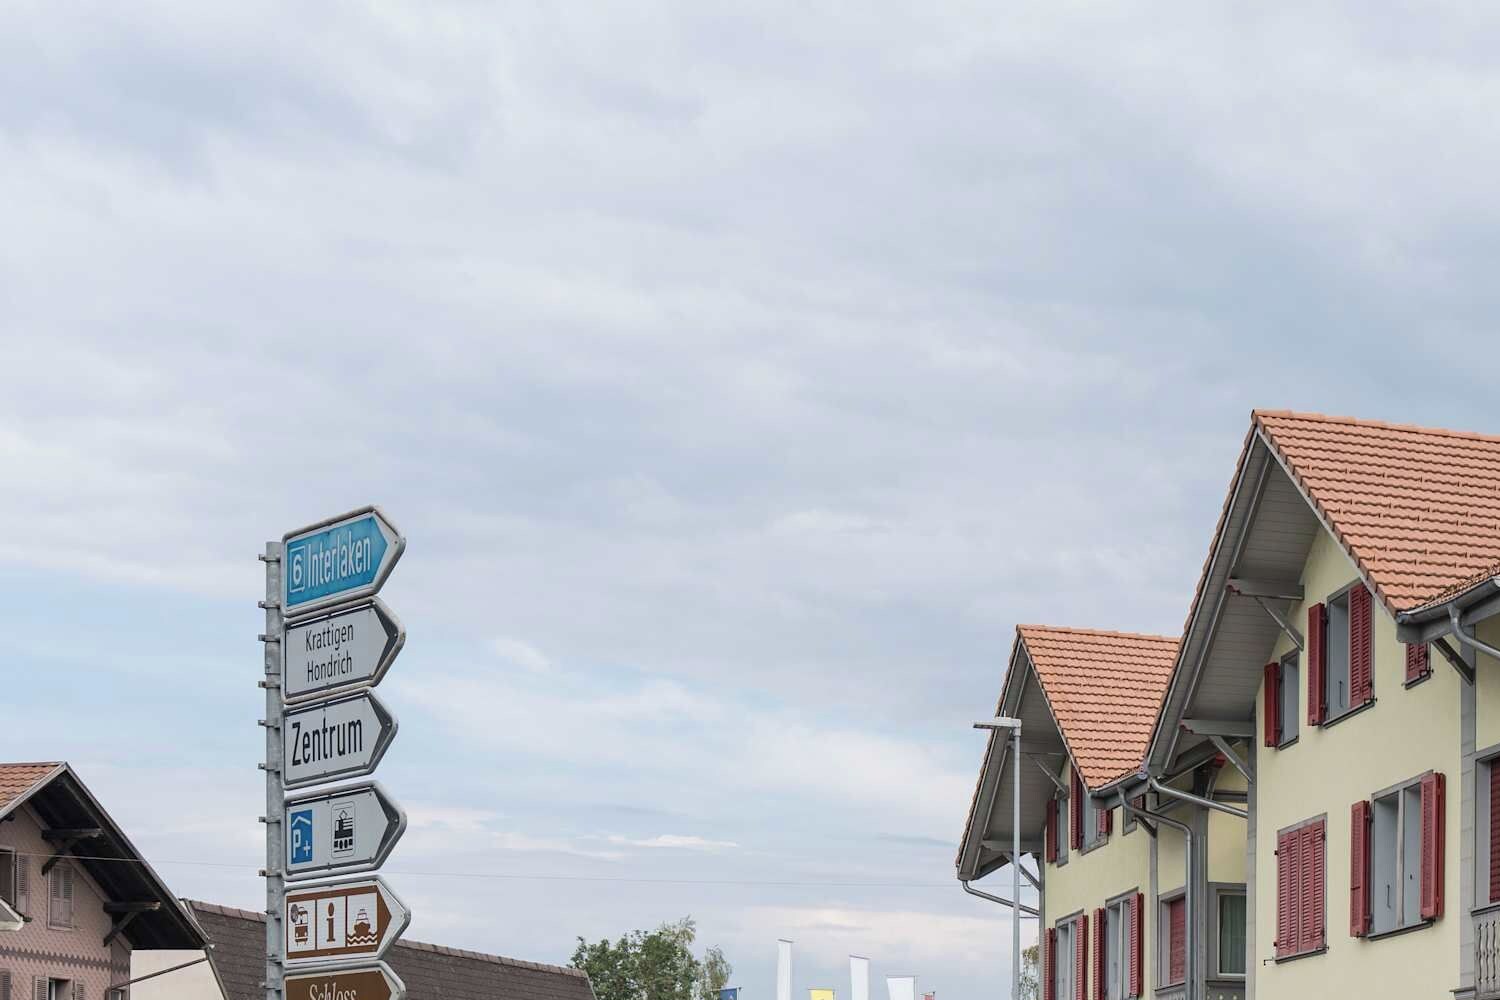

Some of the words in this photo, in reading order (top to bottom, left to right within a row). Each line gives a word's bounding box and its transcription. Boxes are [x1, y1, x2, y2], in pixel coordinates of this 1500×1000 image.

[291, 557, 303, 585] 6
[307, 531, 371, 590] Interlaken
[305, 622, 354, 652] Krattigen
[306, 653, 353, 682] Hondrich
[291, 718, 363, 766] Zentrum
